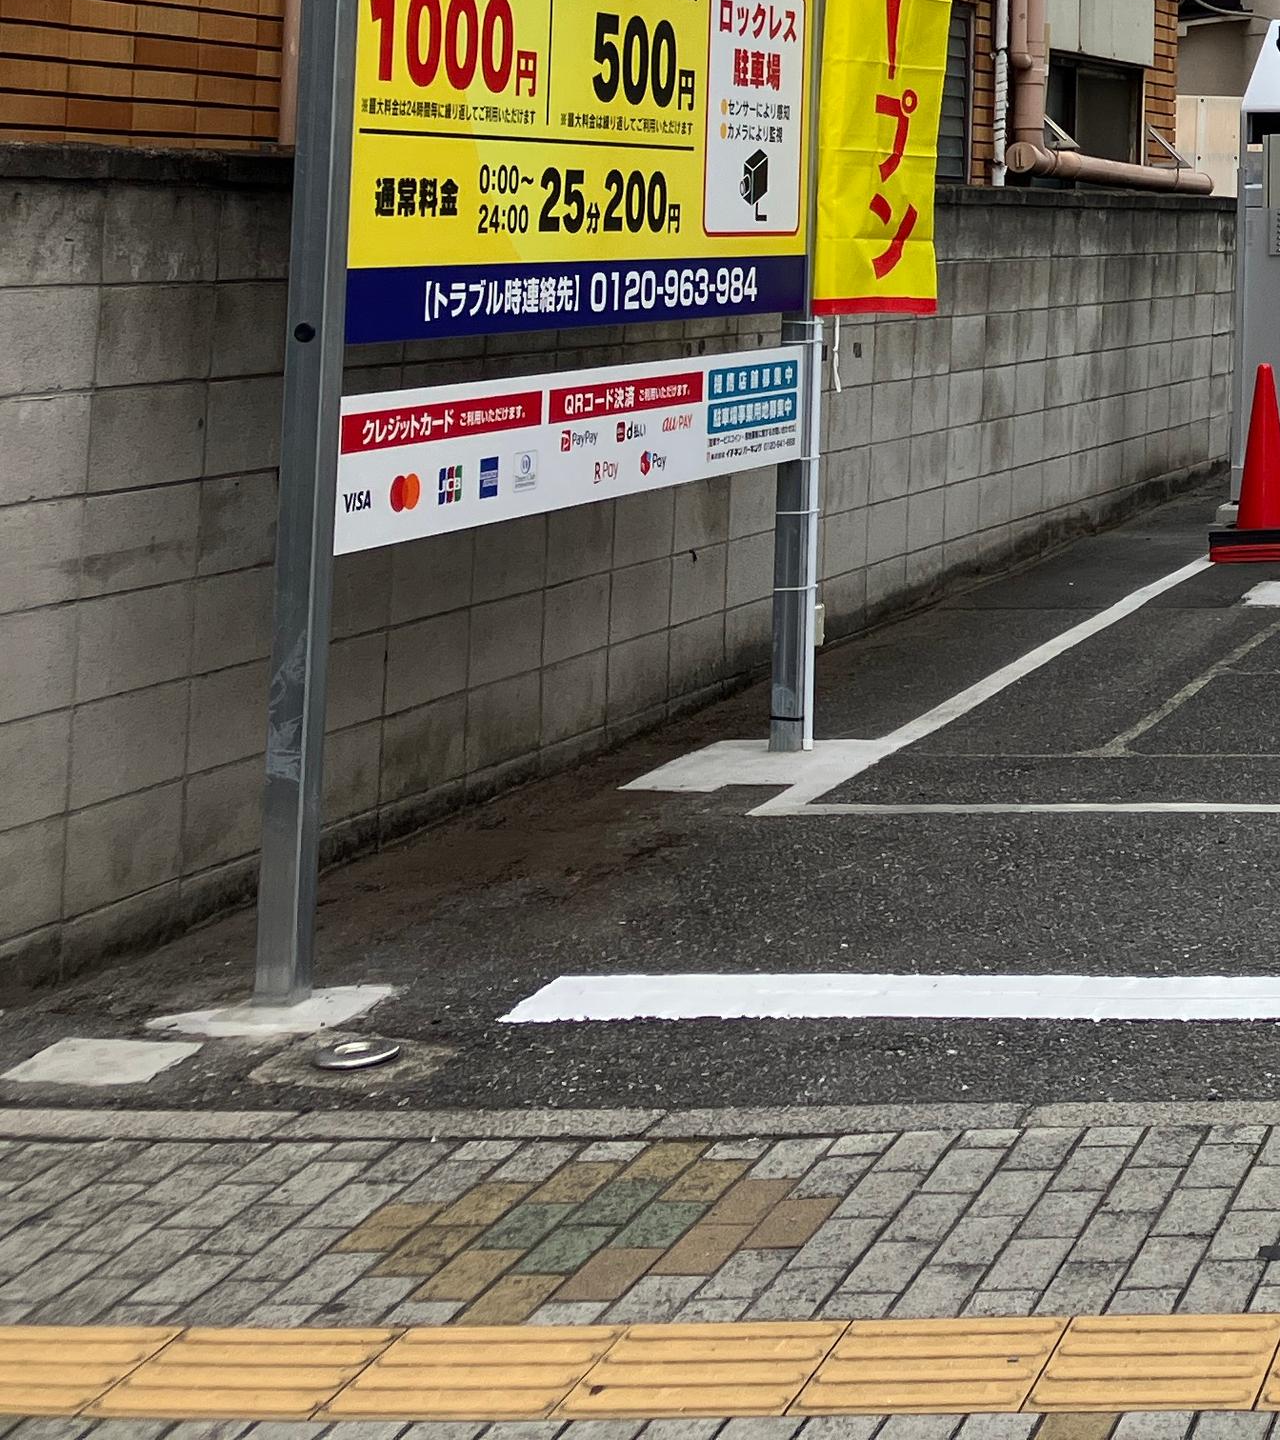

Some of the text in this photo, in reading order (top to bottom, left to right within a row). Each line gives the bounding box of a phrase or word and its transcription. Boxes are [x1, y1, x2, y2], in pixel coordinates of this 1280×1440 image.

[719, 0, 797, 43] ロックレス
[593, 12, 696, 112] 500円
[733, 48, 782, 92] 駐車場
[728, 99, 791, 121] センサーにより感知
[727, 123, 784, 143] カメラにより監視
[375, 178, 459, 217] 通常料金
[477, 204, 529, 234] 24:00
[590, 266, 757, 312] 0120-963-984
[564, 385, 636, 415] QRコード決済
[362, 407, 455, 445] クレジットカード
[572, 430, 598, 448] PayPay
[343, 490, 371, 513] VISA
